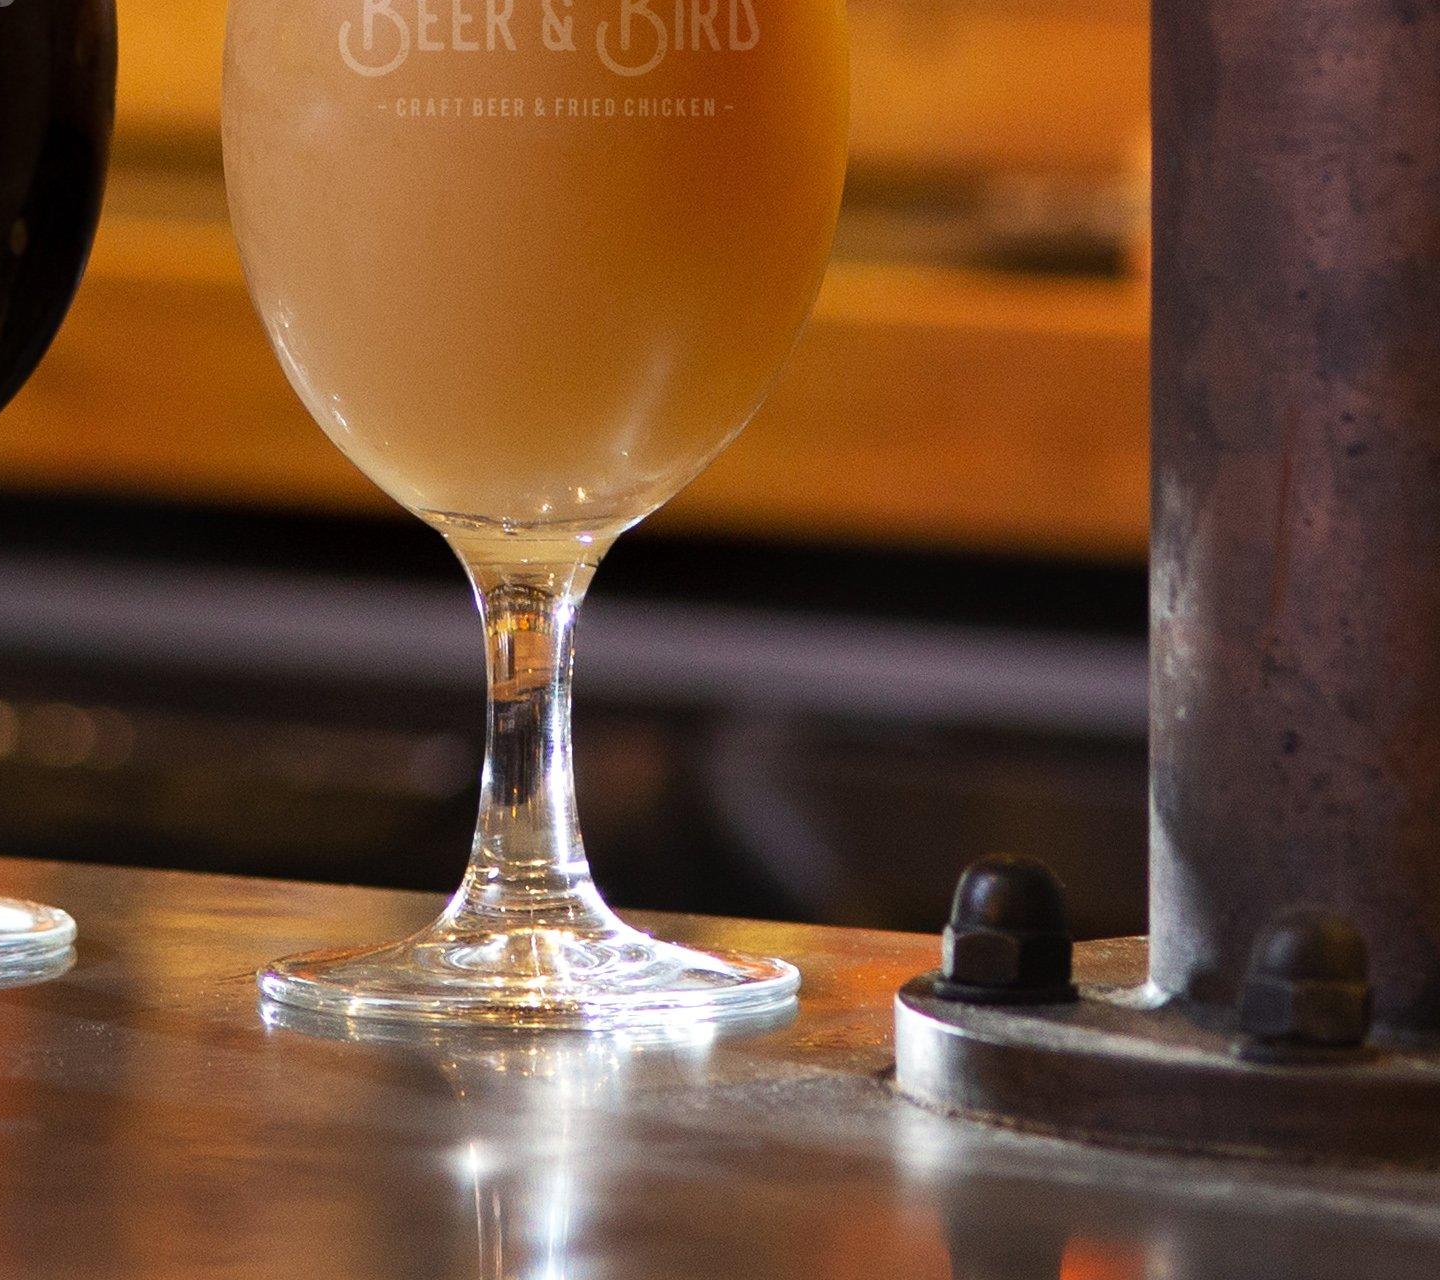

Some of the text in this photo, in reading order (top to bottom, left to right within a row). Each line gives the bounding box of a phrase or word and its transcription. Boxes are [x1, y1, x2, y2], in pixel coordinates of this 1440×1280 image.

[396, 97, 715, 118] CRAFT BEER & FRIED CHICKEN
